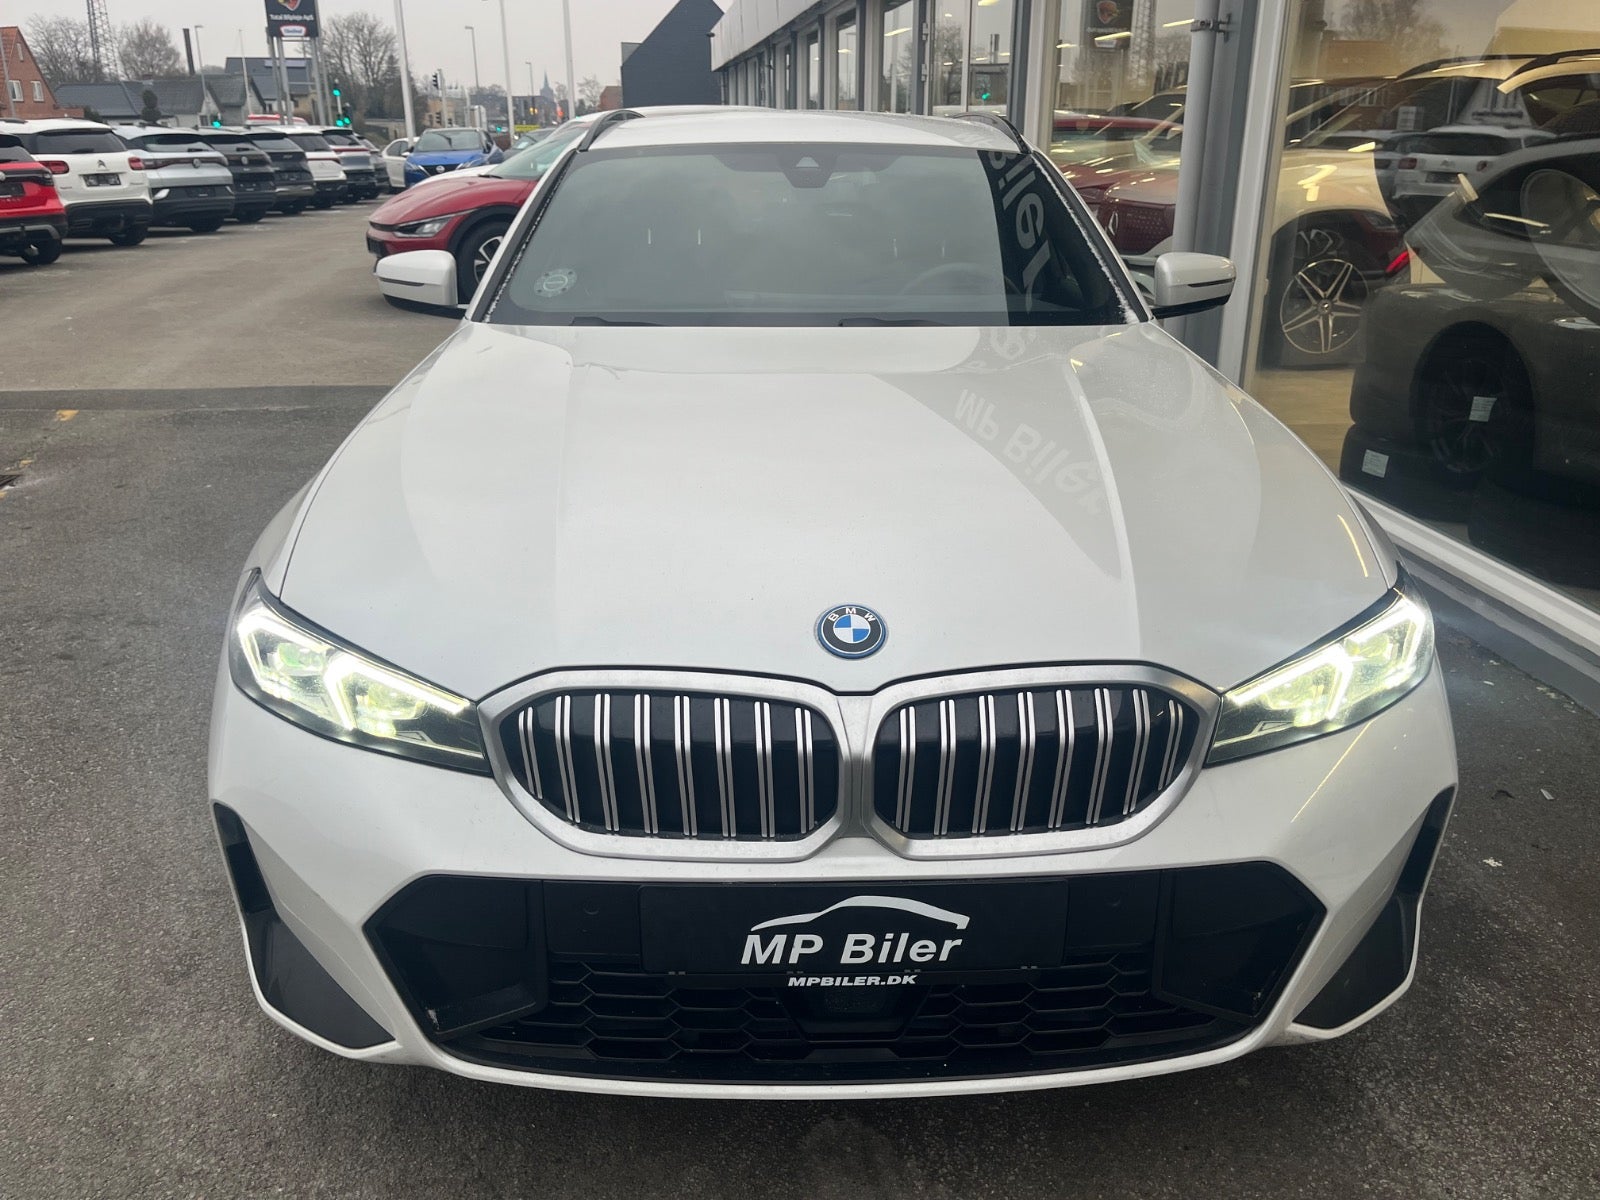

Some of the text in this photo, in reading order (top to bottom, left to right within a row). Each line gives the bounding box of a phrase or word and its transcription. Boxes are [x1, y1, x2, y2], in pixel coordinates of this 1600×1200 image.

[828, 607, 876, 622] BMW
[741, 932, 962, 965] MP Biler
[787, 974, 918, 987] MPBILER.DK
